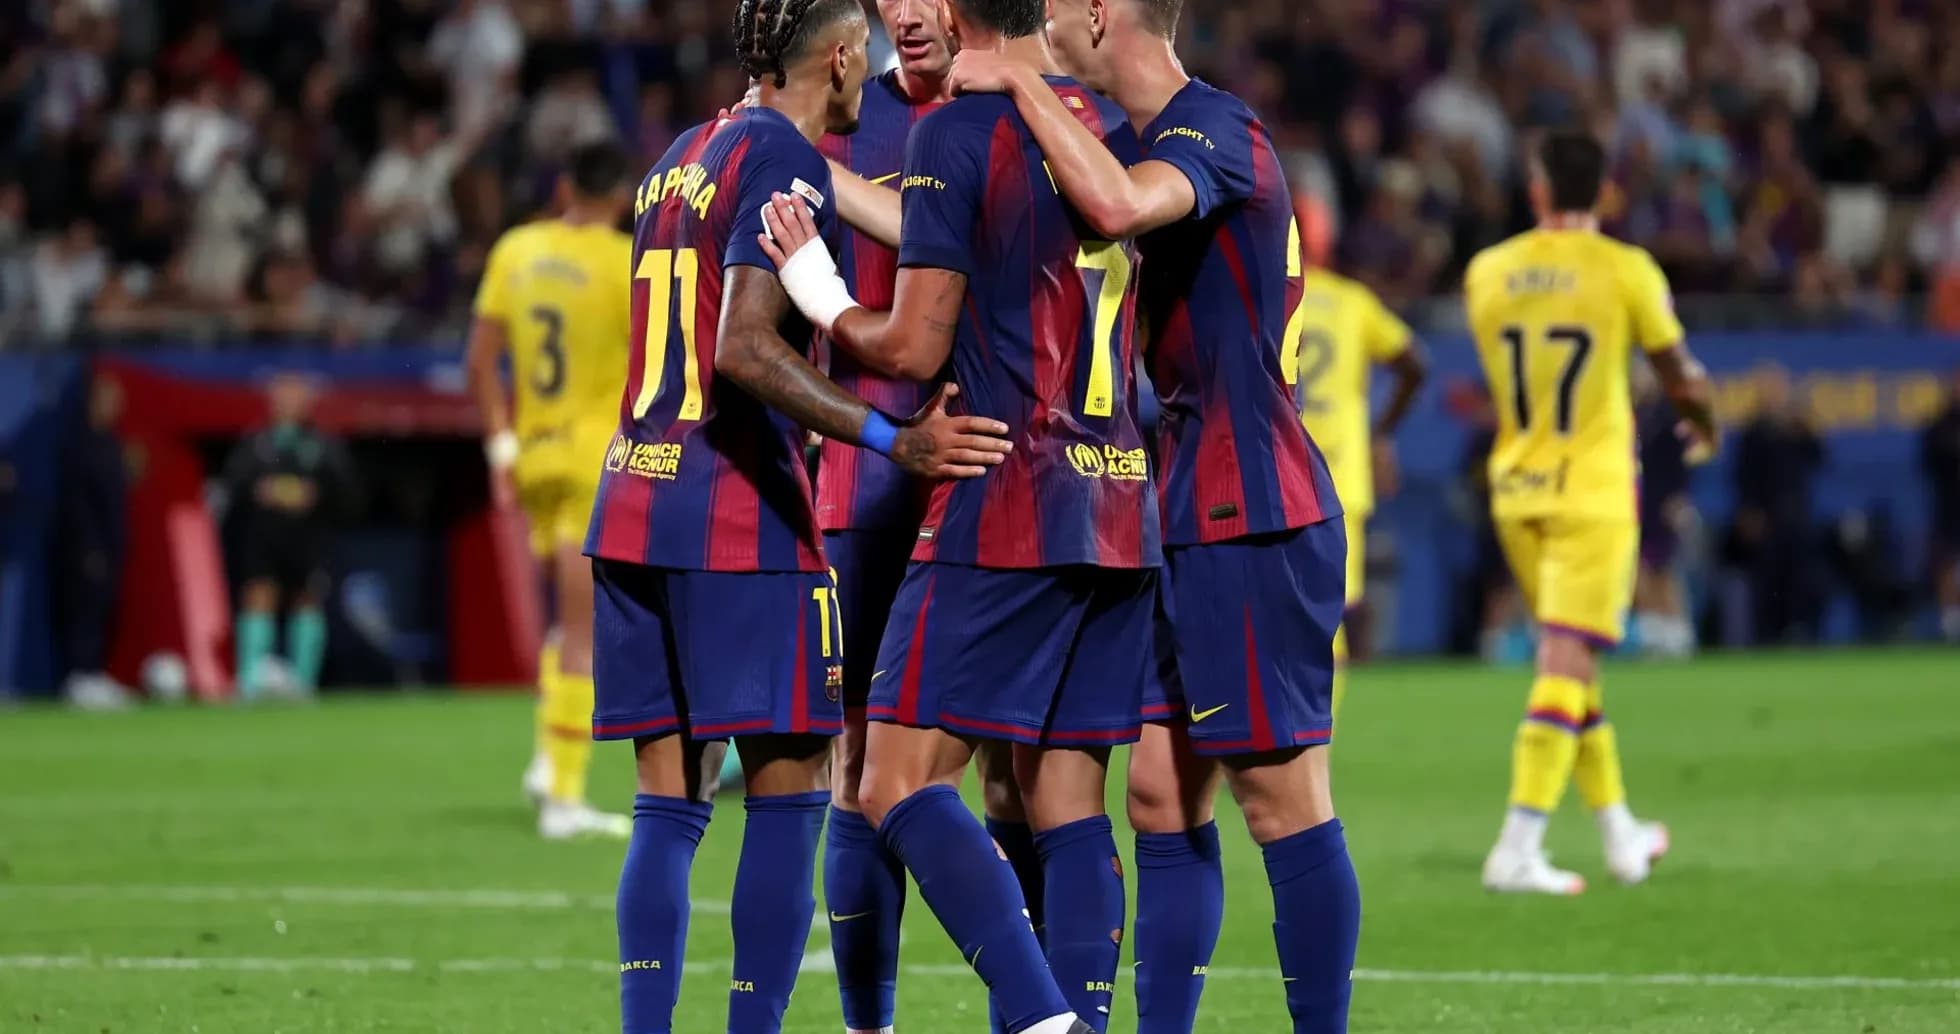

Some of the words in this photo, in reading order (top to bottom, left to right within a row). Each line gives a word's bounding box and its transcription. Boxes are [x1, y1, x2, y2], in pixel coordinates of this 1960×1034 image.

[934, 179, 946, 190] tv
[530, 304, 566, 399] 3
[634, 248, 703, 420] 11
[1075, 240, 1131, 417] 7
[1501, 325, 1594, 435] 17
[628, 453, 678, 473] ACNUR
[1107, 459, 1146, 475] ACNU
